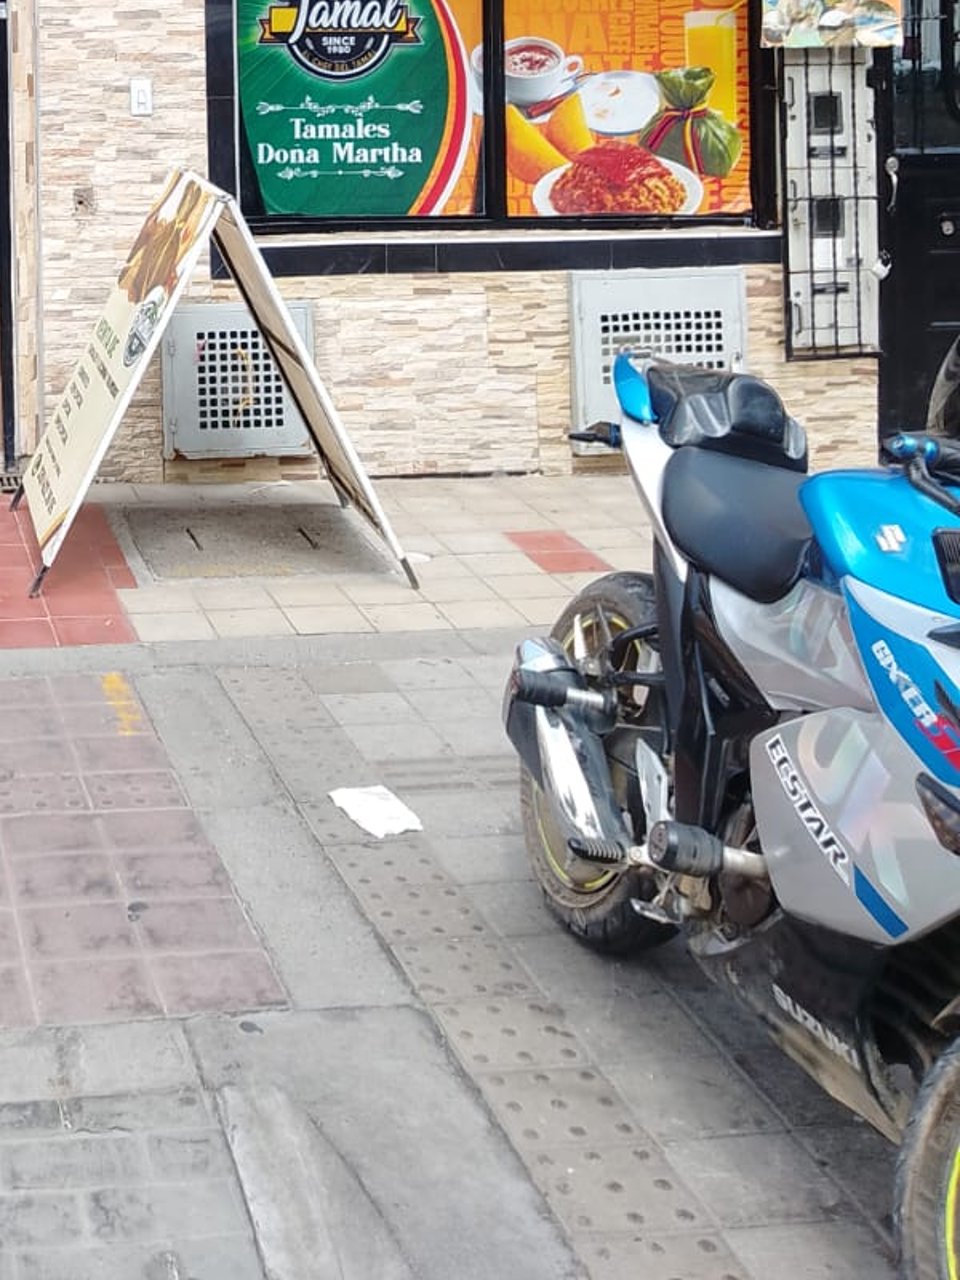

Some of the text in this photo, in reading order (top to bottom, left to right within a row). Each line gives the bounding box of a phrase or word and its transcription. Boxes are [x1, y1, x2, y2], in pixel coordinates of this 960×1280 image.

[321, 36, 356, 46] SINCE
[326, 45, 352, 54] 1980
[289, 117, 392, 140] Tamales
[332, 140, 424, 164] Martha
[766, 733, 850, 886] ECSTAR
